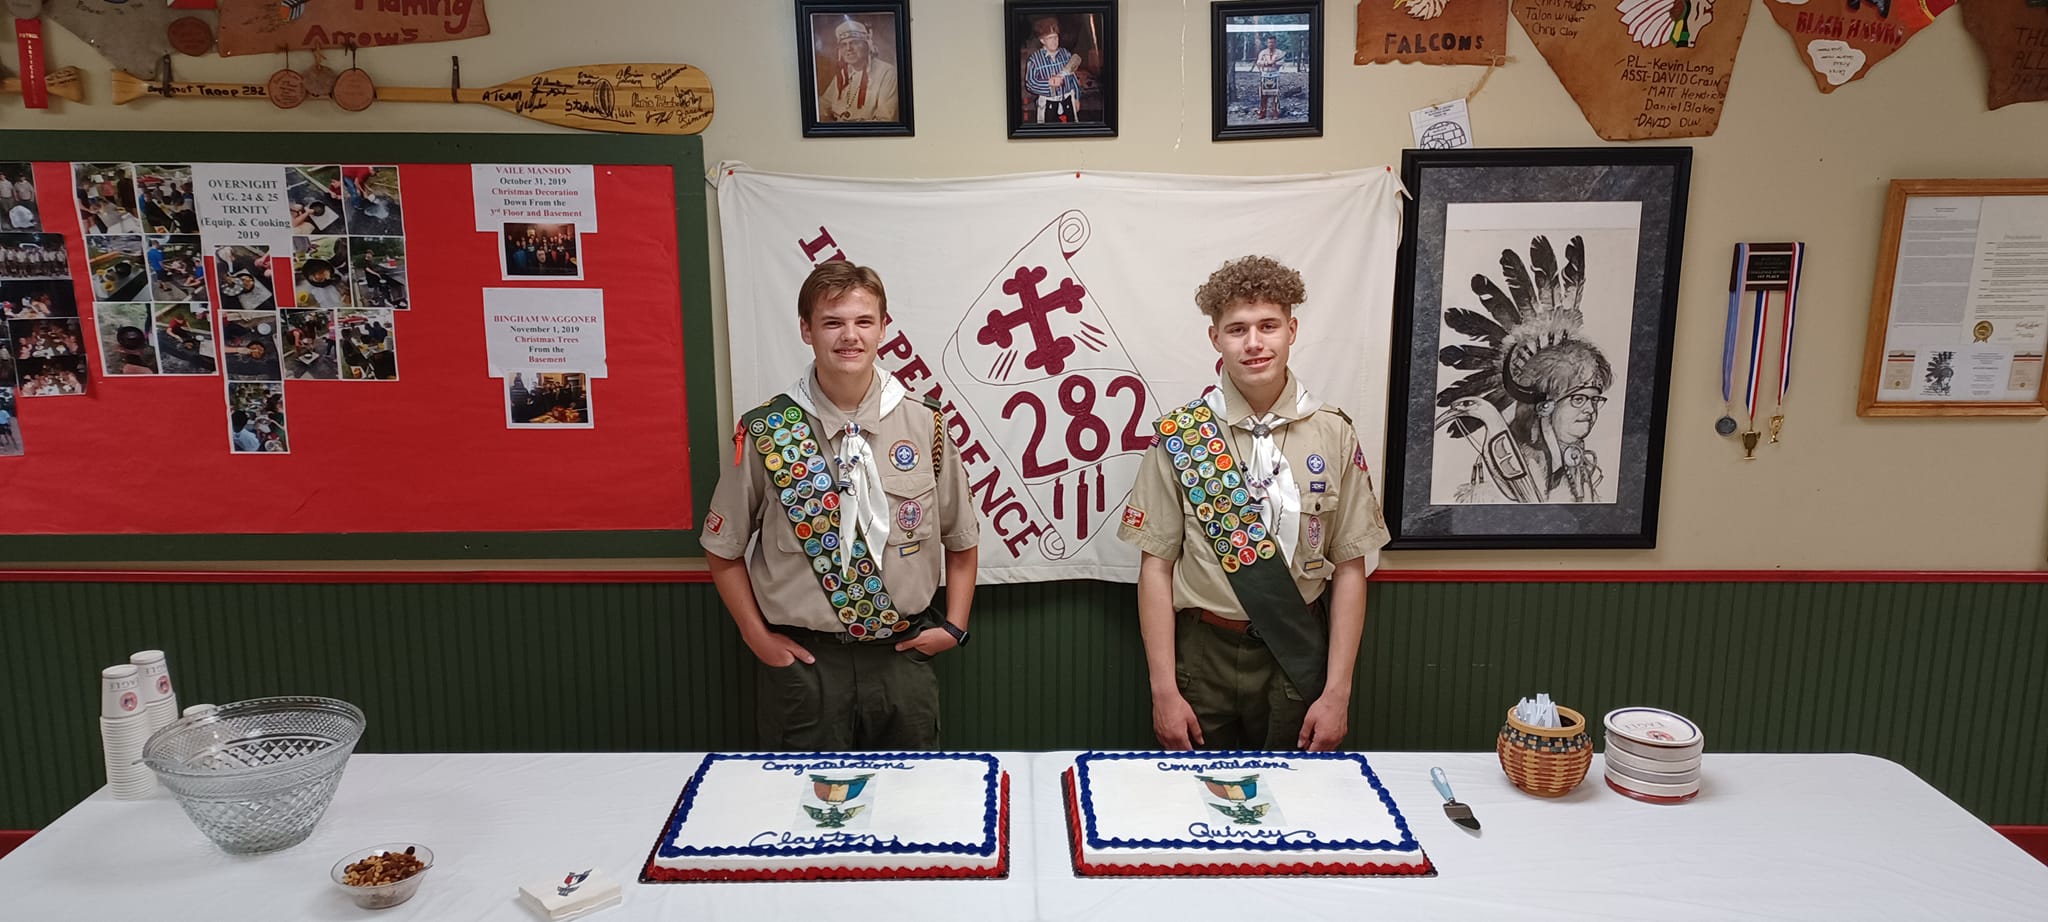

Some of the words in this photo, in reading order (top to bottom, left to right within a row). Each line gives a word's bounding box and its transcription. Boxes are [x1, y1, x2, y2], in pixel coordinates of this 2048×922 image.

[1384, 32, 1485, 54] FALCONS
[1685, 60, 1715, 75] Long
[242, 86, 267, 96] 282
[1644, 98, 1682, 112] Daniel
[495, 166, 525, 175] VAILE
[527, 167, 572, 175] MANSION
[208, 179, 278, 190] OVERNIGHT
[500, 177, 532, 186] October
[534, 177, 547, 187] 31,
[548, 178, 567, 186] 2019
[491, 187, 533, 196] Christmas
[535, 188, 579, 196] Decoration
[211, 192, 238, 202] AUG.
[241, 193, 252, 202] 24
[255, 193, 264, 202] &
[267, 192, 279, 201] 25
[503, 198, 527, 207] Down
[529, 198, 552, 207] From
[553, 198, 567, 207] the
[222, 205, 269, 215] TRINITY
[503, 208, 524, 217] Floor
[526, 208, 541, 217] and
[543, 208, 582, 217] Basement
[200, 217, 235, 229] (Equip.
[238, 218, 247, 227] &
[250, 218, 291, 229] Cooking
[237, 230, 260, 240] 2019
[493, 314, 540, 323] BINGHAM
[541, 315, 597, 324] WAGGONER
[510, 325, 550, 333] November
[552, 326, 560, 334] 1,
[562, 325, 580, 334] 2019
[514, 335, 556, 344] Christmas
[558, 335, 579, 344] Trees
[528, 345, 550, 353] From
[552, 345, 565, 353] the
[528, 355, 567, 363] Basement
[1001, 374, 1158, 479] 282
[1188, 822, 1316, 842] Quincy
[749, 831, 898, 850] Clayton
